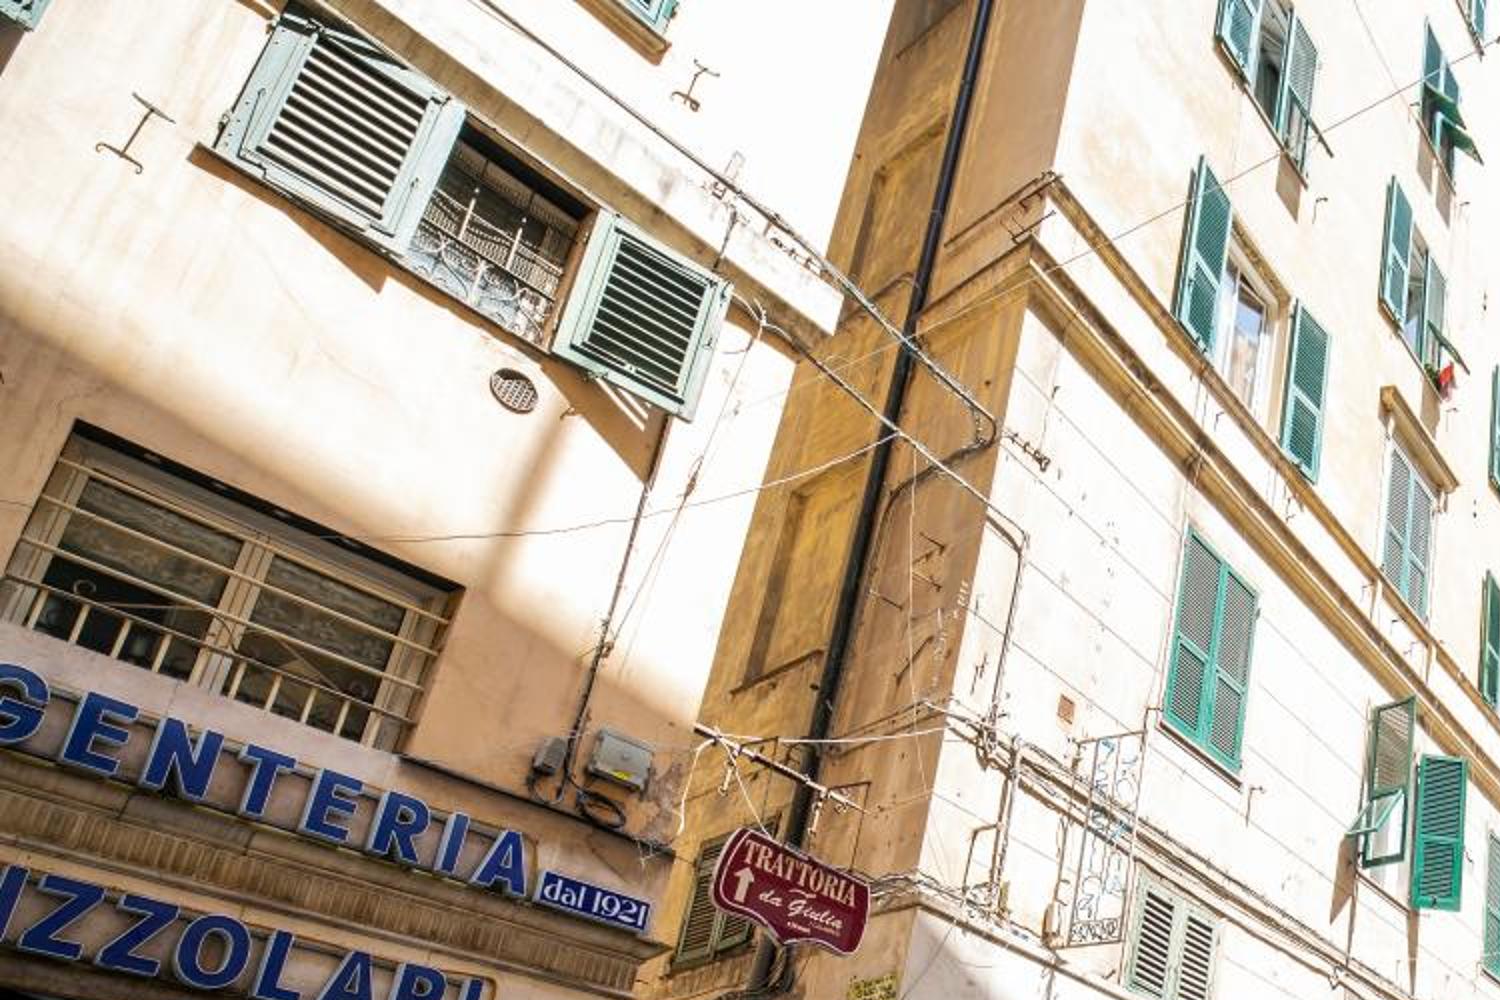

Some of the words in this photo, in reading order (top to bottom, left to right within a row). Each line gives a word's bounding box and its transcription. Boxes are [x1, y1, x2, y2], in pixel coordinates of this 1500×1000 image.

[744, 838, 857, 907] TRATTORIA
[543, 879, 587, 909] dal
[592, 891, 647, 927] 1921
[759, 889, 782, 908] da
